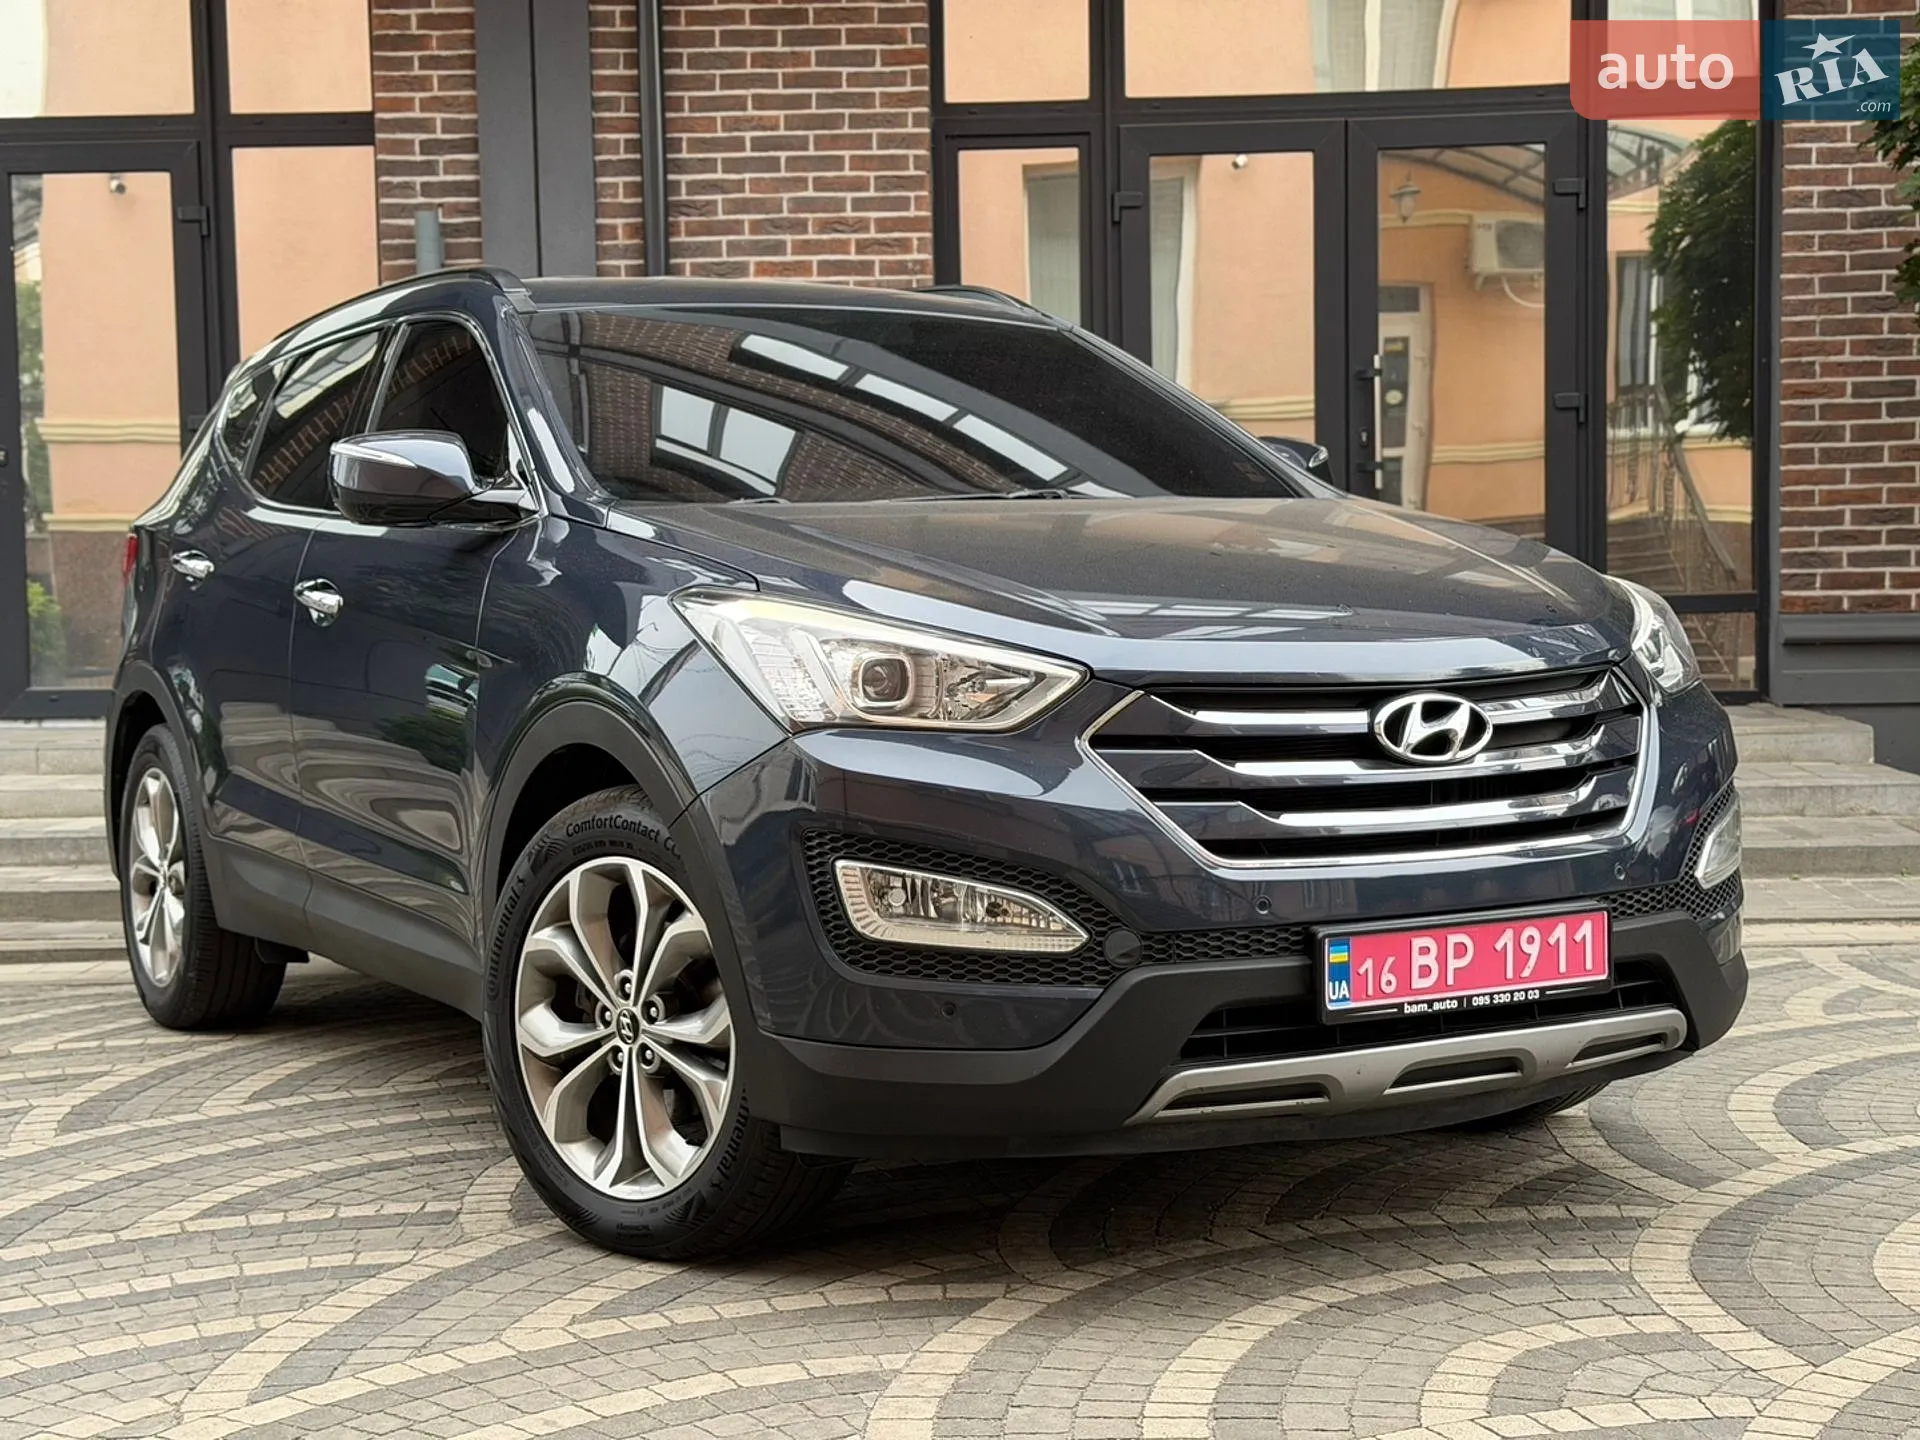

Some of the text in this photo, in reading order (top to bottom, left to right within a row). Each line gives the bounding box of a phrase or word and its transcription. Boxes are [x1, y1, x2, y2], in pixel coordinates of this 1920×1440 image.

[565, 814, 661, 844] ComfortContact
[1356, 919, 1594, 997] 16 BP 1911
[1329, 980, 1350, 1000] UA
[1403, 999, 1459, 1014] bam_auto
[1493, 992, 1511, 1004] 330
[1513, 991, 1526, 1001] 20
[1527, 989, 1540, 999] 03
